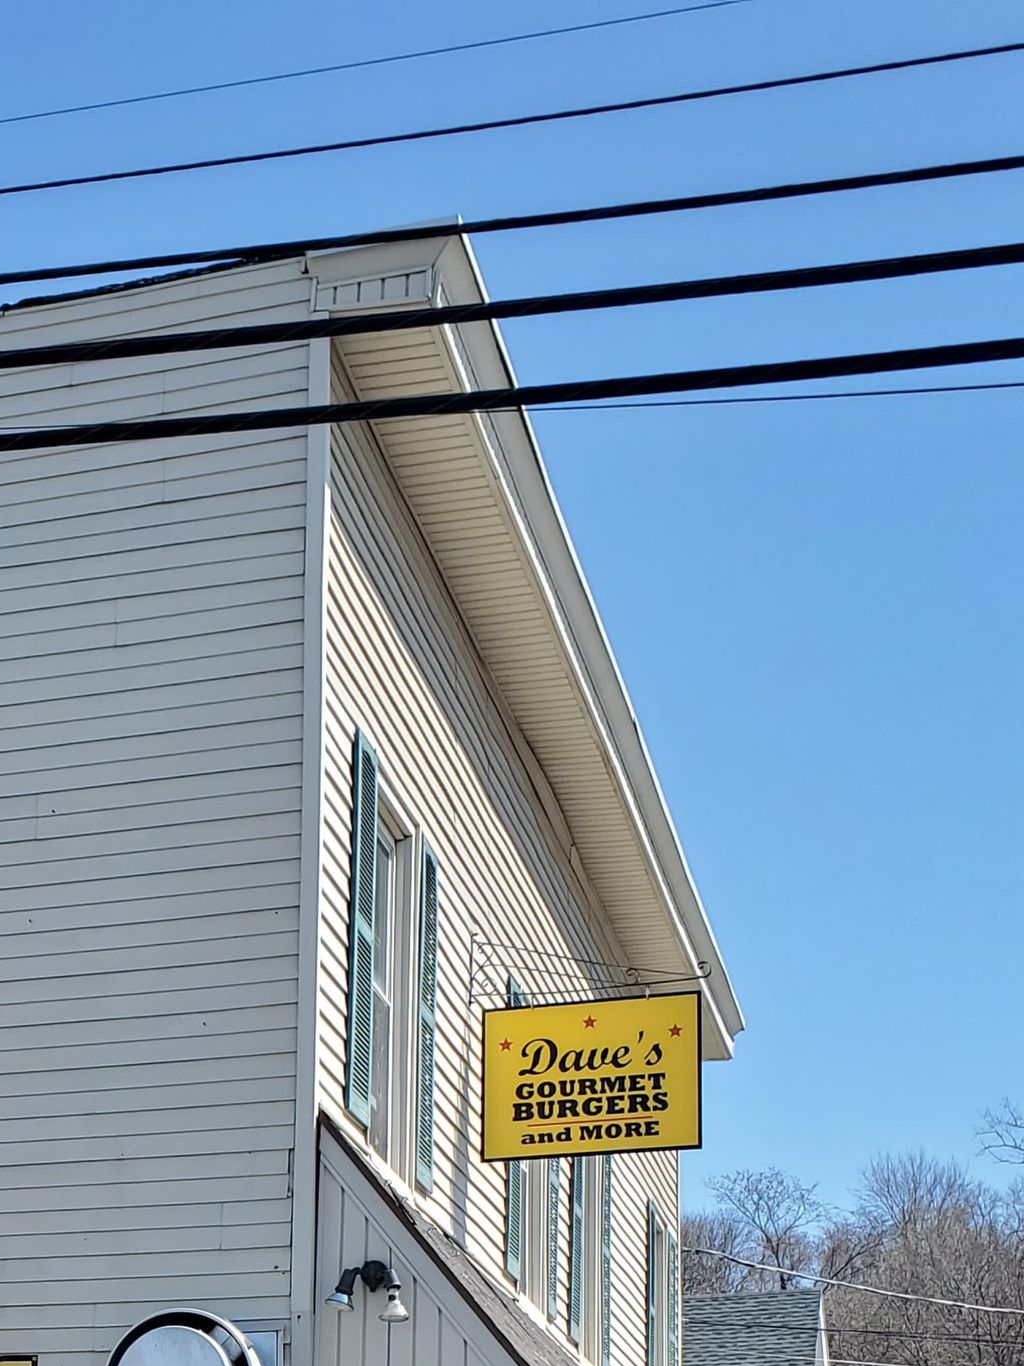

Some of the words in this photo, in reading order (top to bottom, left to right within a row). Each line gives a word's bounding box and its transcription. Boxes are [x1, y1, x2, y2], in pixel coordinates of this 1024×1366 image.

[518, 1030, 663, 1076] Dave's
[515, 1073, 666, 1100] GOURMET
[512, 1092, 669, 1122] BURGERS
[521, 1127, 573, 1145] and
[579, 1121, 660, 1141] MORE
